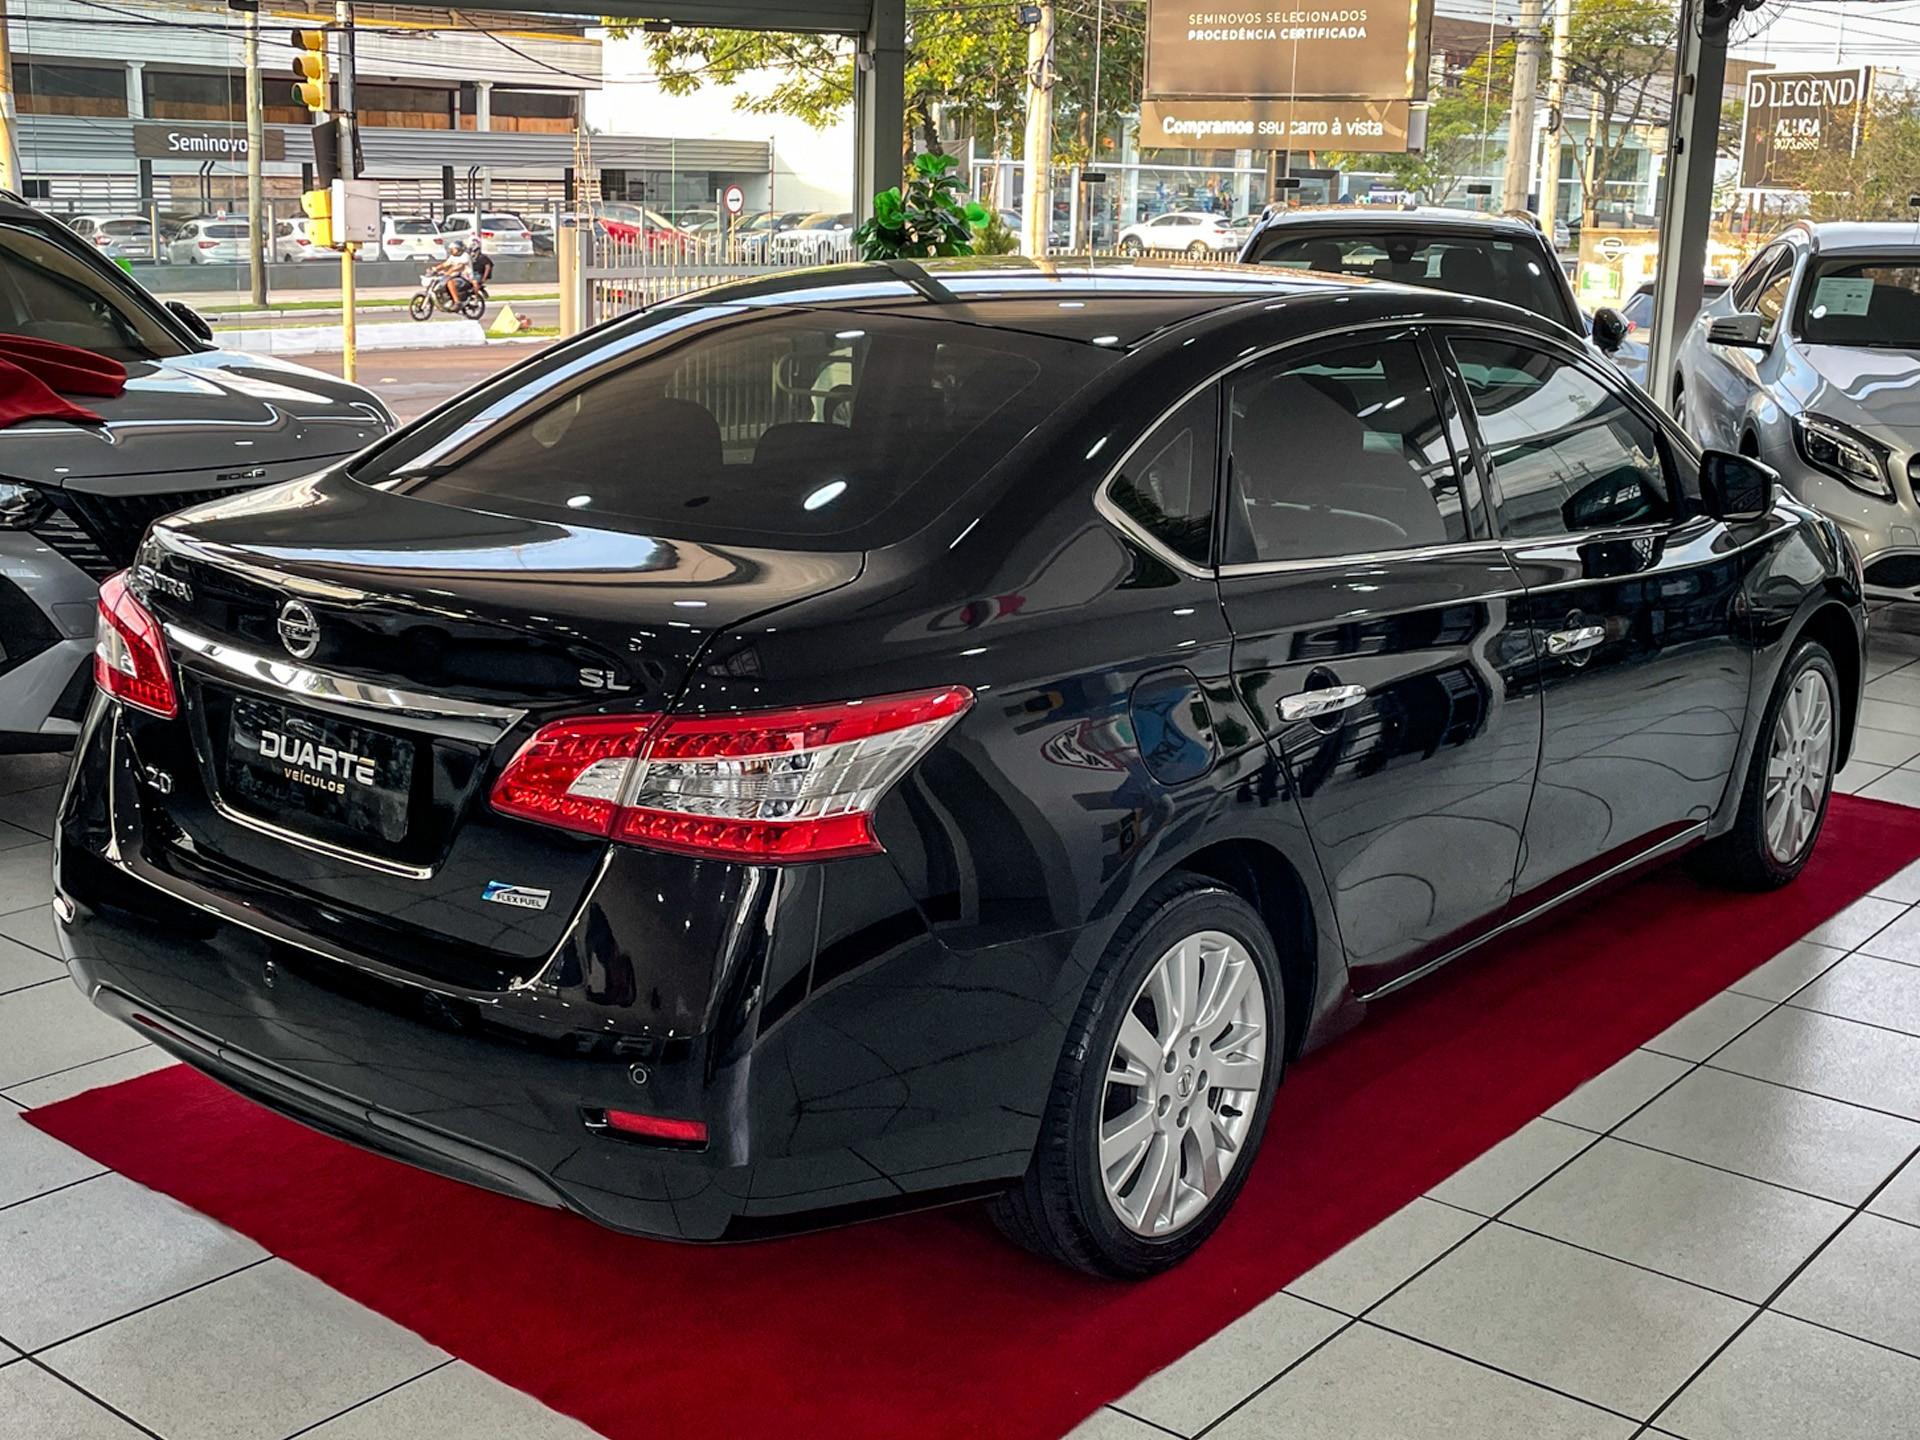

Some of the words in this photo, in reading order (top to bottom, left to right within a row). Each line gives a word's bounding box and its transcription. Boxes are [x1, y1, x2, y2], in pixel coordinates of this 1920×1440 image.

[1188, 12, 1262, 26] SEMINOVOS
[1266, 9, 1368, 24] SELECIONADOS
[1188, 27, 1277, 41] PROCEDÊNCIA
[1280, 26, 1367, 40] CERTIFICADA
[1750, 82, 1767, 108] D
[1769, 78, 1856, 107] LEGEND
[1162, 116, 1254, 139] Compramos
[1258, 120, 1285, 136] seu
[1290, 120, 1328, 136] carro
[1331, 117, 1342, 136] à
[1346, 118, 1383, 136] vista
[168, 132, 248, 152] Seminovo
[580, 668, 631, 691] SL
[259, 730, 376, 786] DUARTE
[497, 893, 519, 904] FLEX
[520, 896, 542, 907] FUEL
